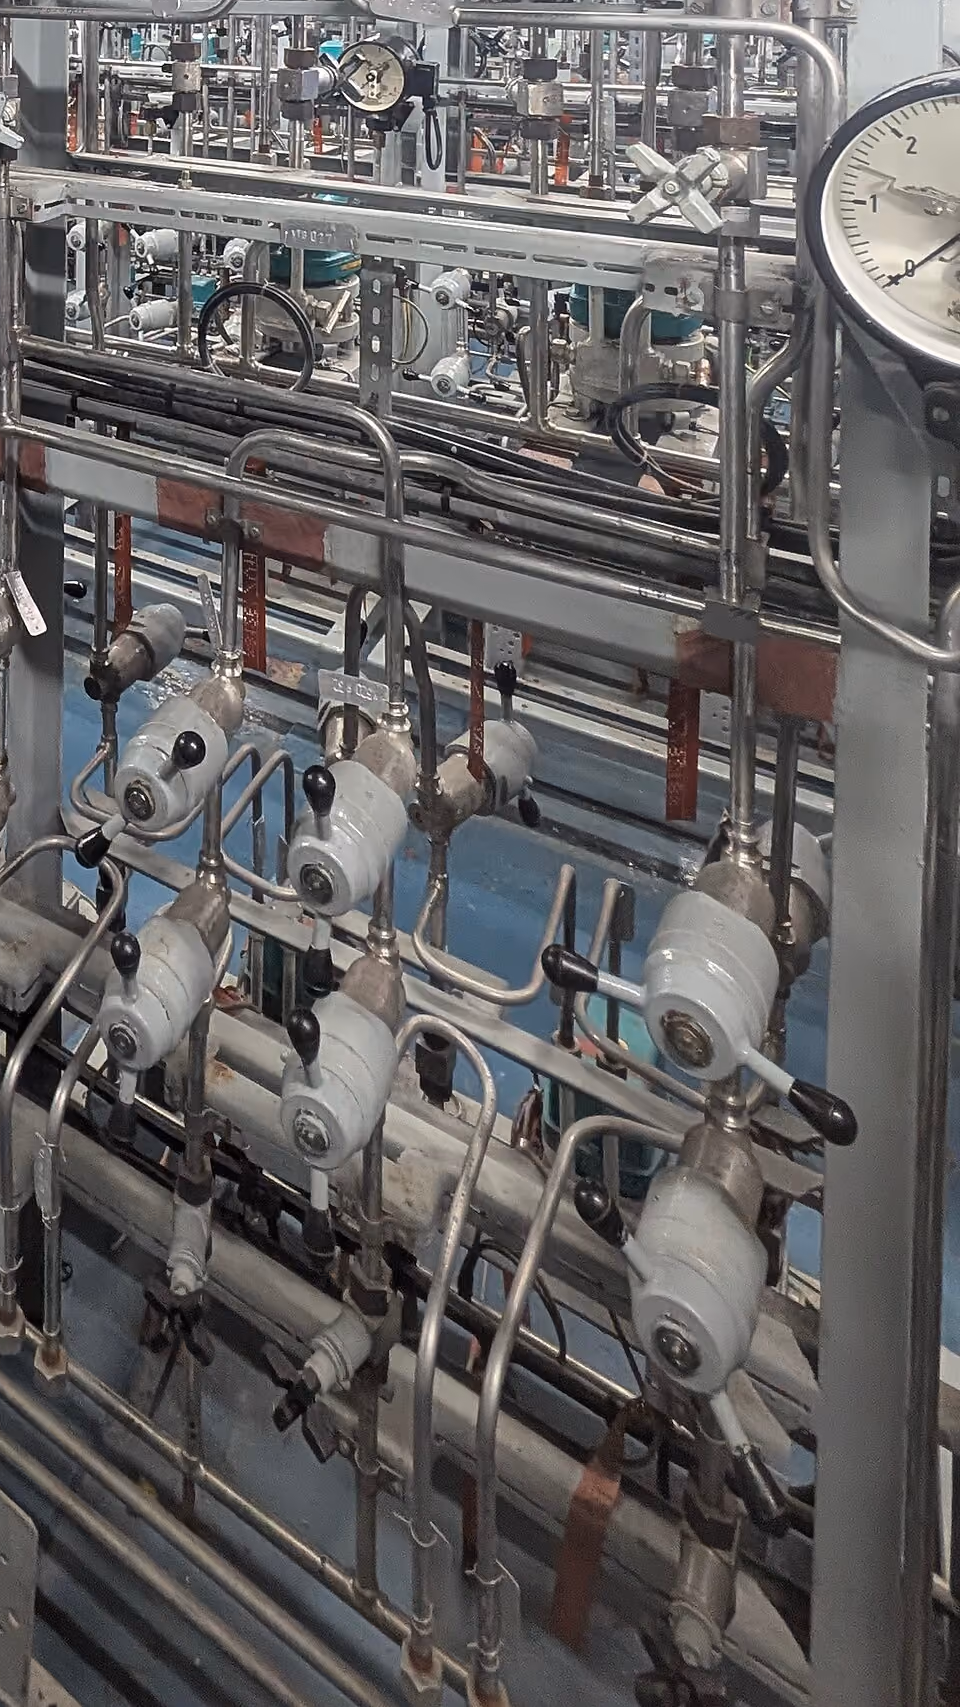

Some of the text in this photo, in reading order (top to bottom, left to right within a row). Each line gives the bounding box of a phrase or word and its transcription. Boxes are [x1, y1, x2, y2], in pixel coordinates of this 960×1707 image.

[905, 135, 918, 155] 2
[869, 194, 878, 213] 1
[905, 259, 916, 278] 0
